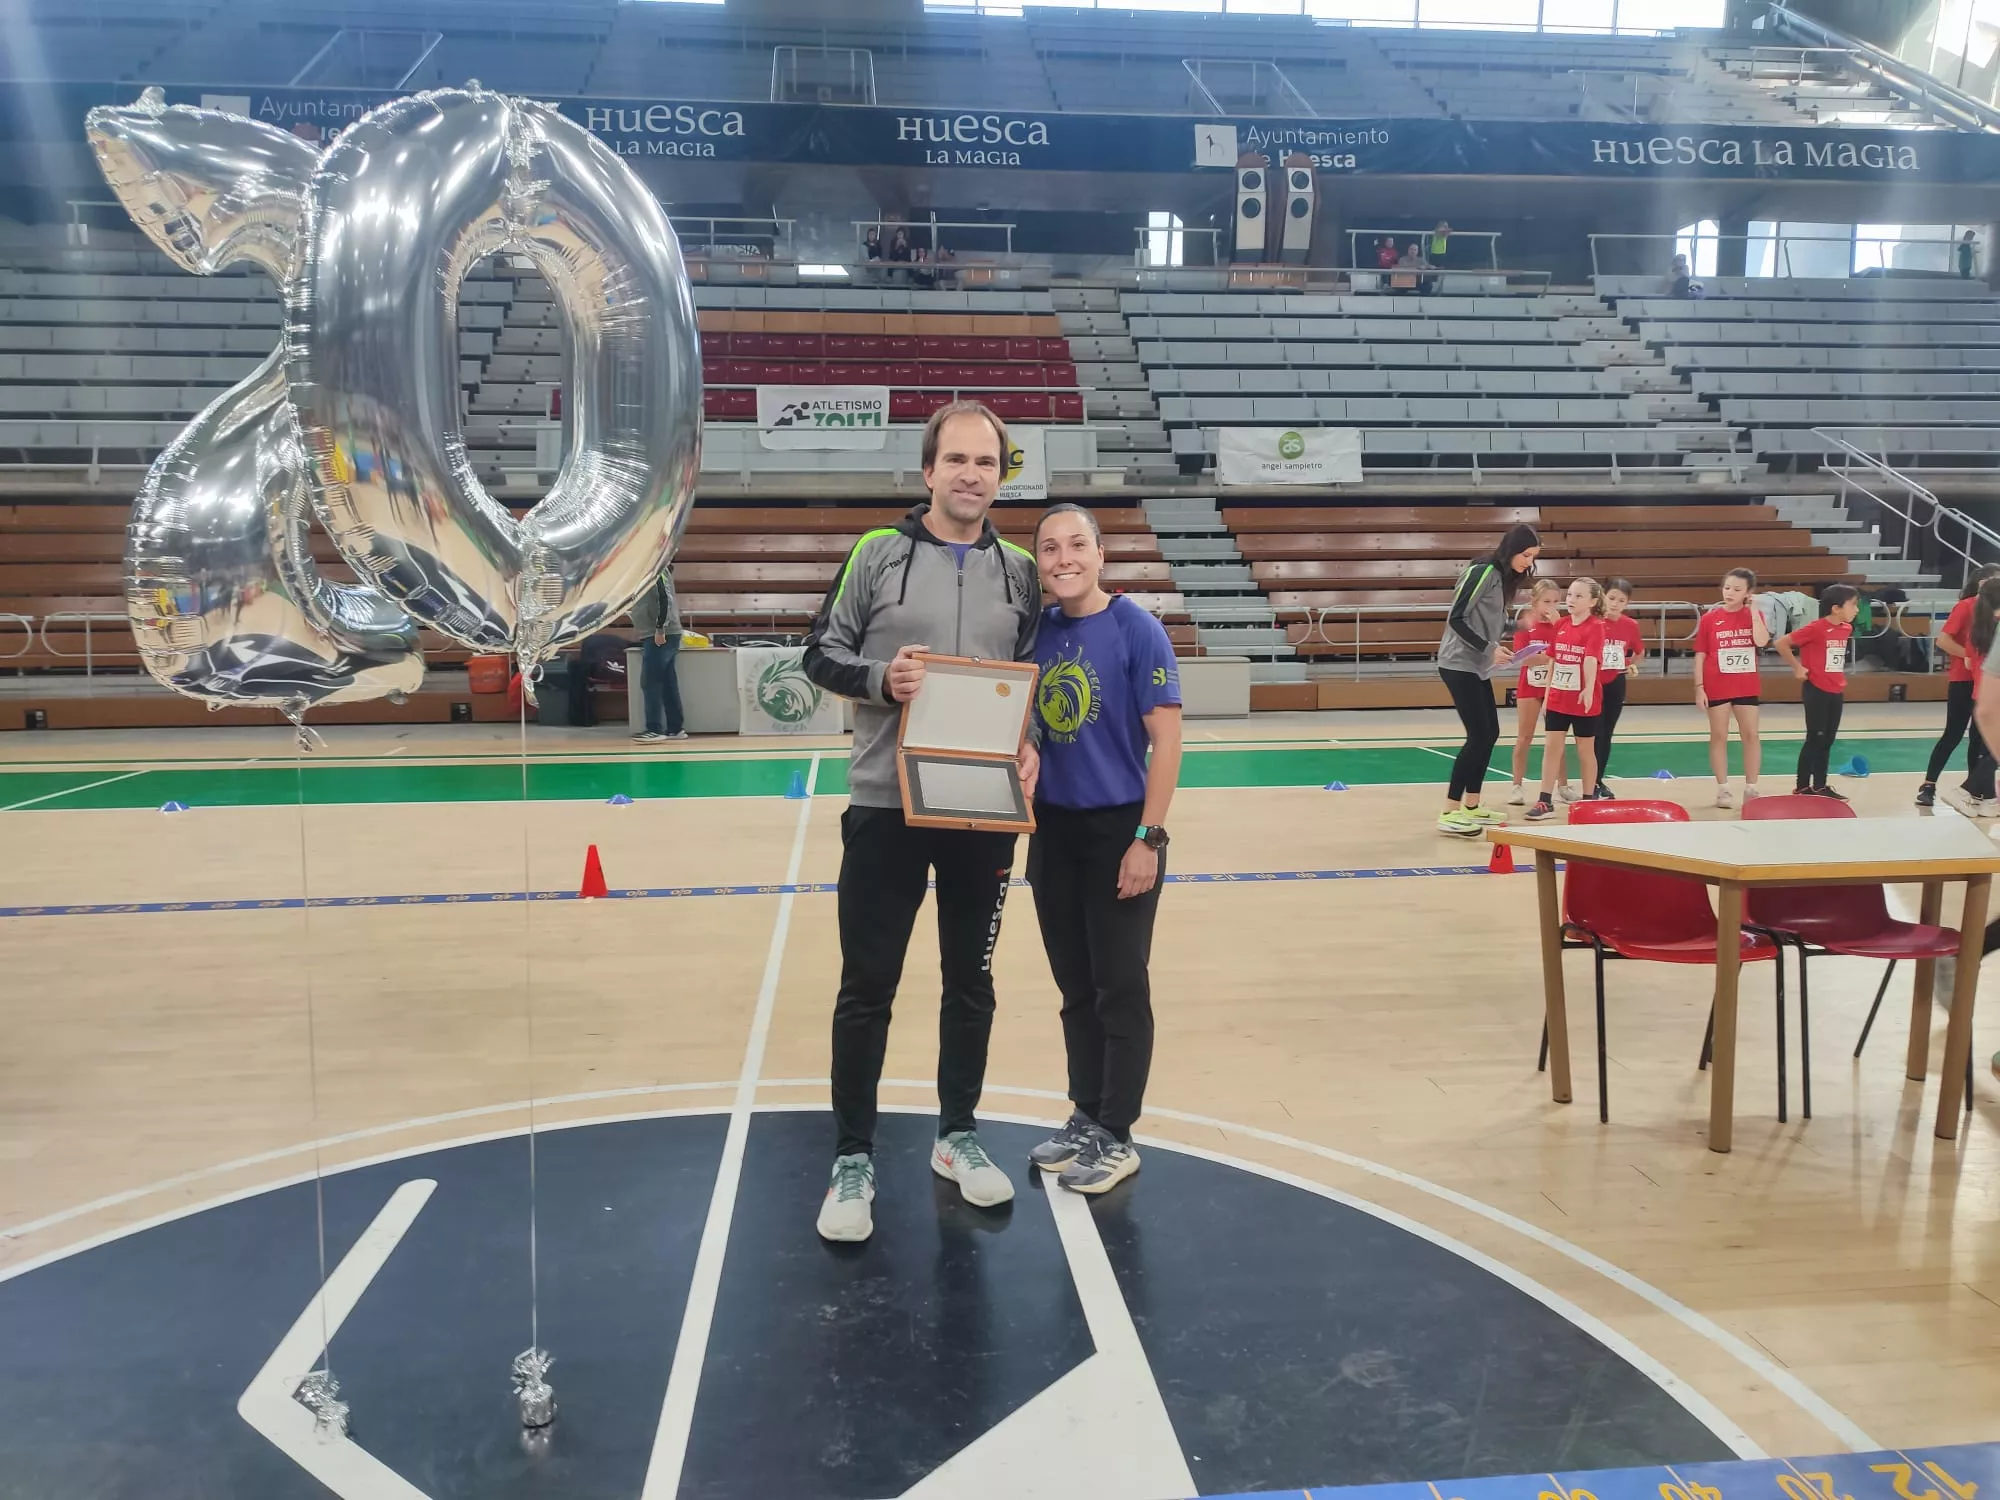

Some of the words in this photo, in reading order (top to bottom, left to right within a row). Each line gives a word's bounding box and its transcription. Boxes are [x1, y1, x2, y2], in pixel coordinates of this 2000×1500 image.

[259, 96, 372, 120] Ayuntami
[1246, 125, 1390, 149] Ayuntamiento
[1278, 149, 1356, 168] Hesca
[812, 400, 882, 411] ATLETISMO
[813, 412, 882, 427] ZOITI
[1261, 462, 1282, 471] angel
[1284, 462, 1323, 471] sampietro
[1726, 654, 1750, 666] 576
[1534, 670, 1548, 681] 57
[1869, 1461, 1979, 1500] 12
